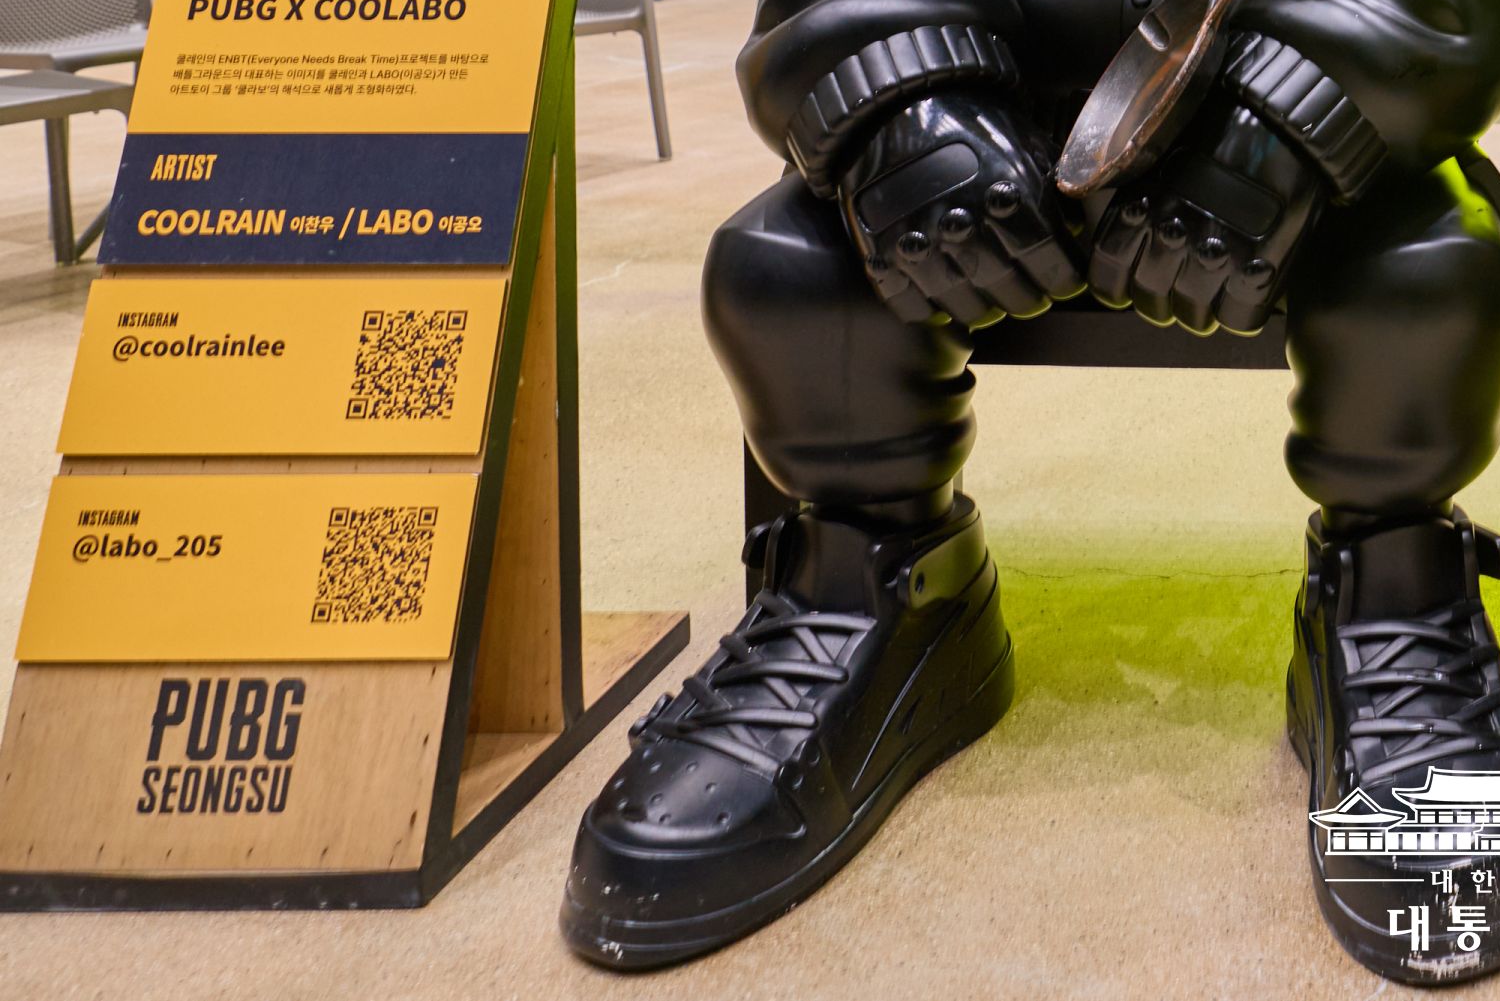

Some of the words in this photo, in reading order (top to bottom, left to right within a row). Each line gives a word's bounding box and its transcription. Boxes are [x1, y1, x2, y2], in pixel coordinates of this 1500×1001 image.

[218, 54, 300, 66] ENBT(Everyone
[301, 54, 335, 64] Needs
[337, 54, 368, 64] Break
[450, 53, 489, 65] 바탕으로
[244, 69, 284, 80] 대표하는
[449, 68, 469, 80] 만든
[170, 84, 210, 96] 아트토이
[281, 84, 321, 96] 해석으로
[150, 154, 218, 181] ARTIST
[137, 209, 287, 236] COOLRAIN
[290, 215, 335, 234] 이찬우
[356, 209, 434, 235] LABO
[438, 215, 482, 234] 이공오
[117, 312, 179, 328] INSTAGRAM
[112, 333, 286, 362] @coolrainlee
[77, 510, 141, 527] INSTAGRAM
[72, 533, 223, 563] @labo_205
[146, 678, 306, 762] PUBG
[136, 765, 293, 814] SEONGSU
